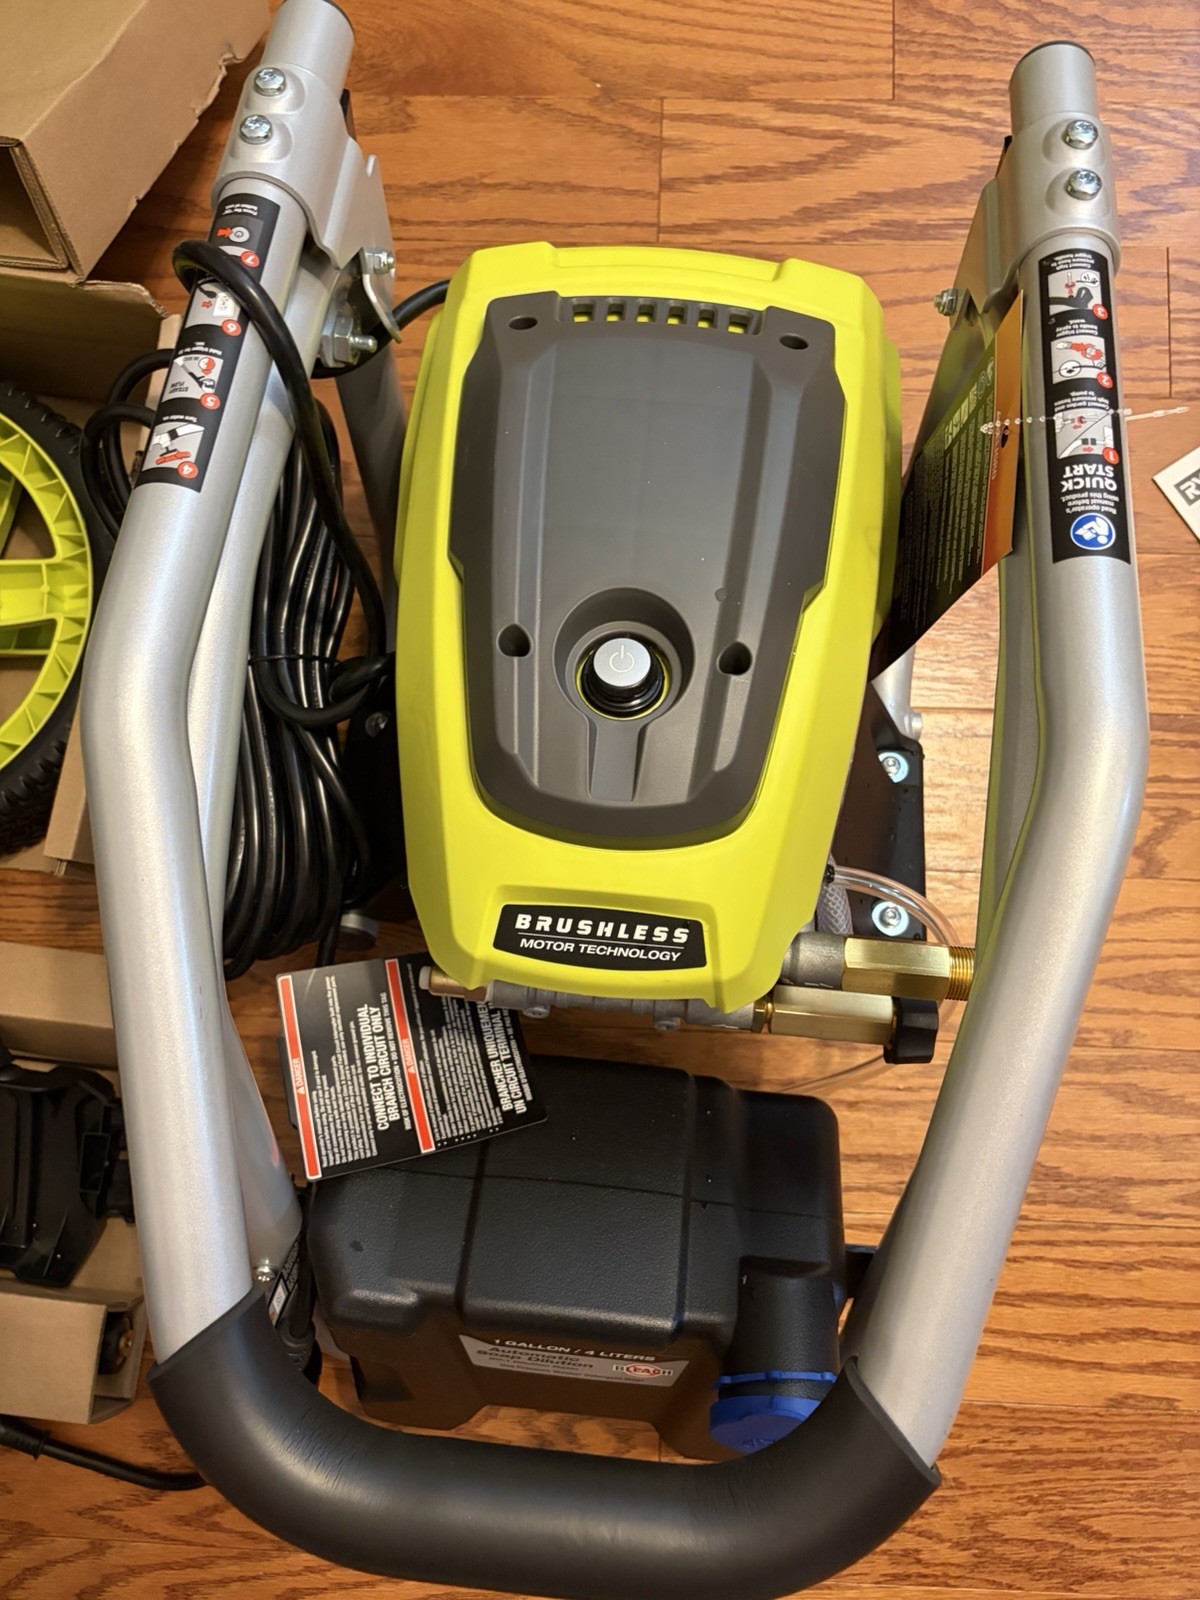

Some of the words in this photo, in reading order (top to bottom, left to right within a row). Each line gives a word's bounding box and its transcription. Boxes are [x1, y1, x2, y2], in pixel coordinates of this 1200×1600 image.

[1063, 464, 1114, 478] START
[1060, 477, 1117, 492] QUICK
[1060, 492, 1088, 502] product.
[1103, 492, 1119, 502] using
[1066, 505, 1100, 513] operator's
[1101, 506, 1116, 514] Read
[515, 913, 690, 944] BRUSHLESS
[519, 938, 575, 953] MOTOR
[579, 942, 682, 962] TECHNOLOGY
[369, 1006, 383, 1032] ONLY
[384, 1017, 393, 1039] REMOVE
[477, 1000, 497, 1058] UNIQUEMEN
[357, 1004, 375, 1063] INDIVIDUAL
[491, 1010, 510, 1060] TERMINAL
[374, 1034, 390, 1076] CIRCUIT
[390, 1051, 397, 1060] DO
[400, 1038, 413, 1065] DANGER
[292, 1057, 303, 1086] DANGER
[367, 1064, 379, 1080] TO
[502, 1062, 521, 1099] CIRCUIT
[393, 1065, 406, 1108] ELECTROCUTION
[490, 1059, 511, 1111] BRANCHER
[370, 1081, 388, 1130] CONNECT
[382, 1077, 399, 1121] BRANCH
[513, 1099, 526, 1113] UN
[401, 1108, 408, 1116] OF
[403, 1116, 411, 1130] RISK
[476, 1349, 521, 1360] Soap
[527, 1356, 593, 1368] Dilution
[489, 1347, 580, 1362] Automatic
[505, 1340, 571, 1353] GALLON
[599, 1351, 656, 1361] LITERS
